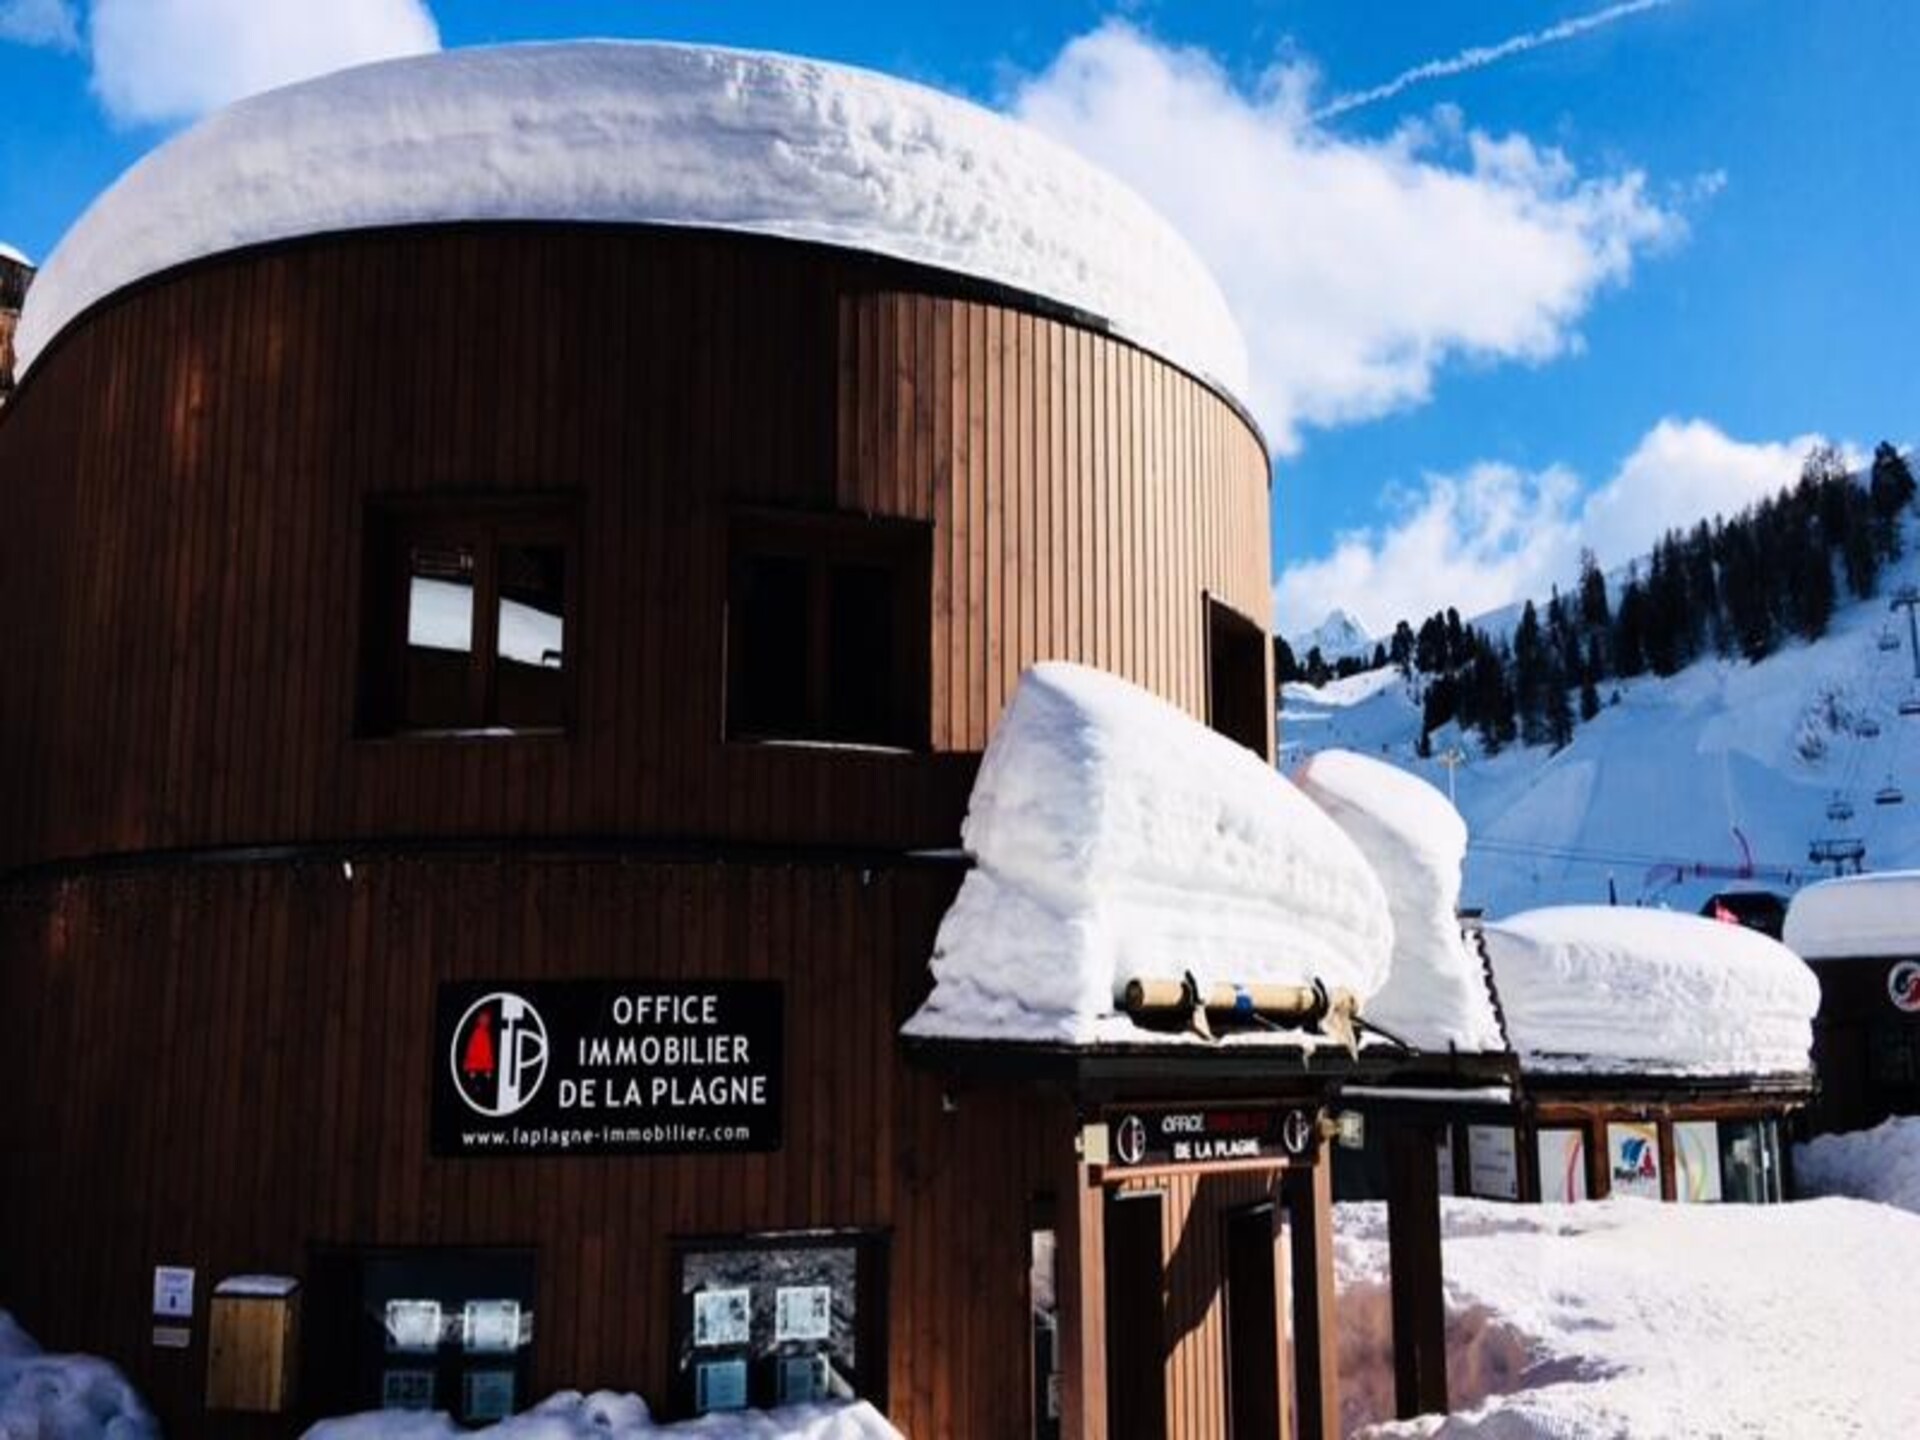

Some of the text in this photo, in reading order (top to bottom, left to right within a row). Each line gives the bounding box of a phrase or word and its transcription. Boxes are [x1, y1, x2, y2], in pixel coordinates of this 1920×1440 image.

[613, 995, 718, 1024] OFFICE
[578, 1036, 750, 1066] IMMOBILIER
[558, 1075, 767, 1108] DE LA PLAGNE
[461, 1124, 750, 1148] www.laplagne-immobilier.com
[1194, 1140, 1213, 1159] LA
